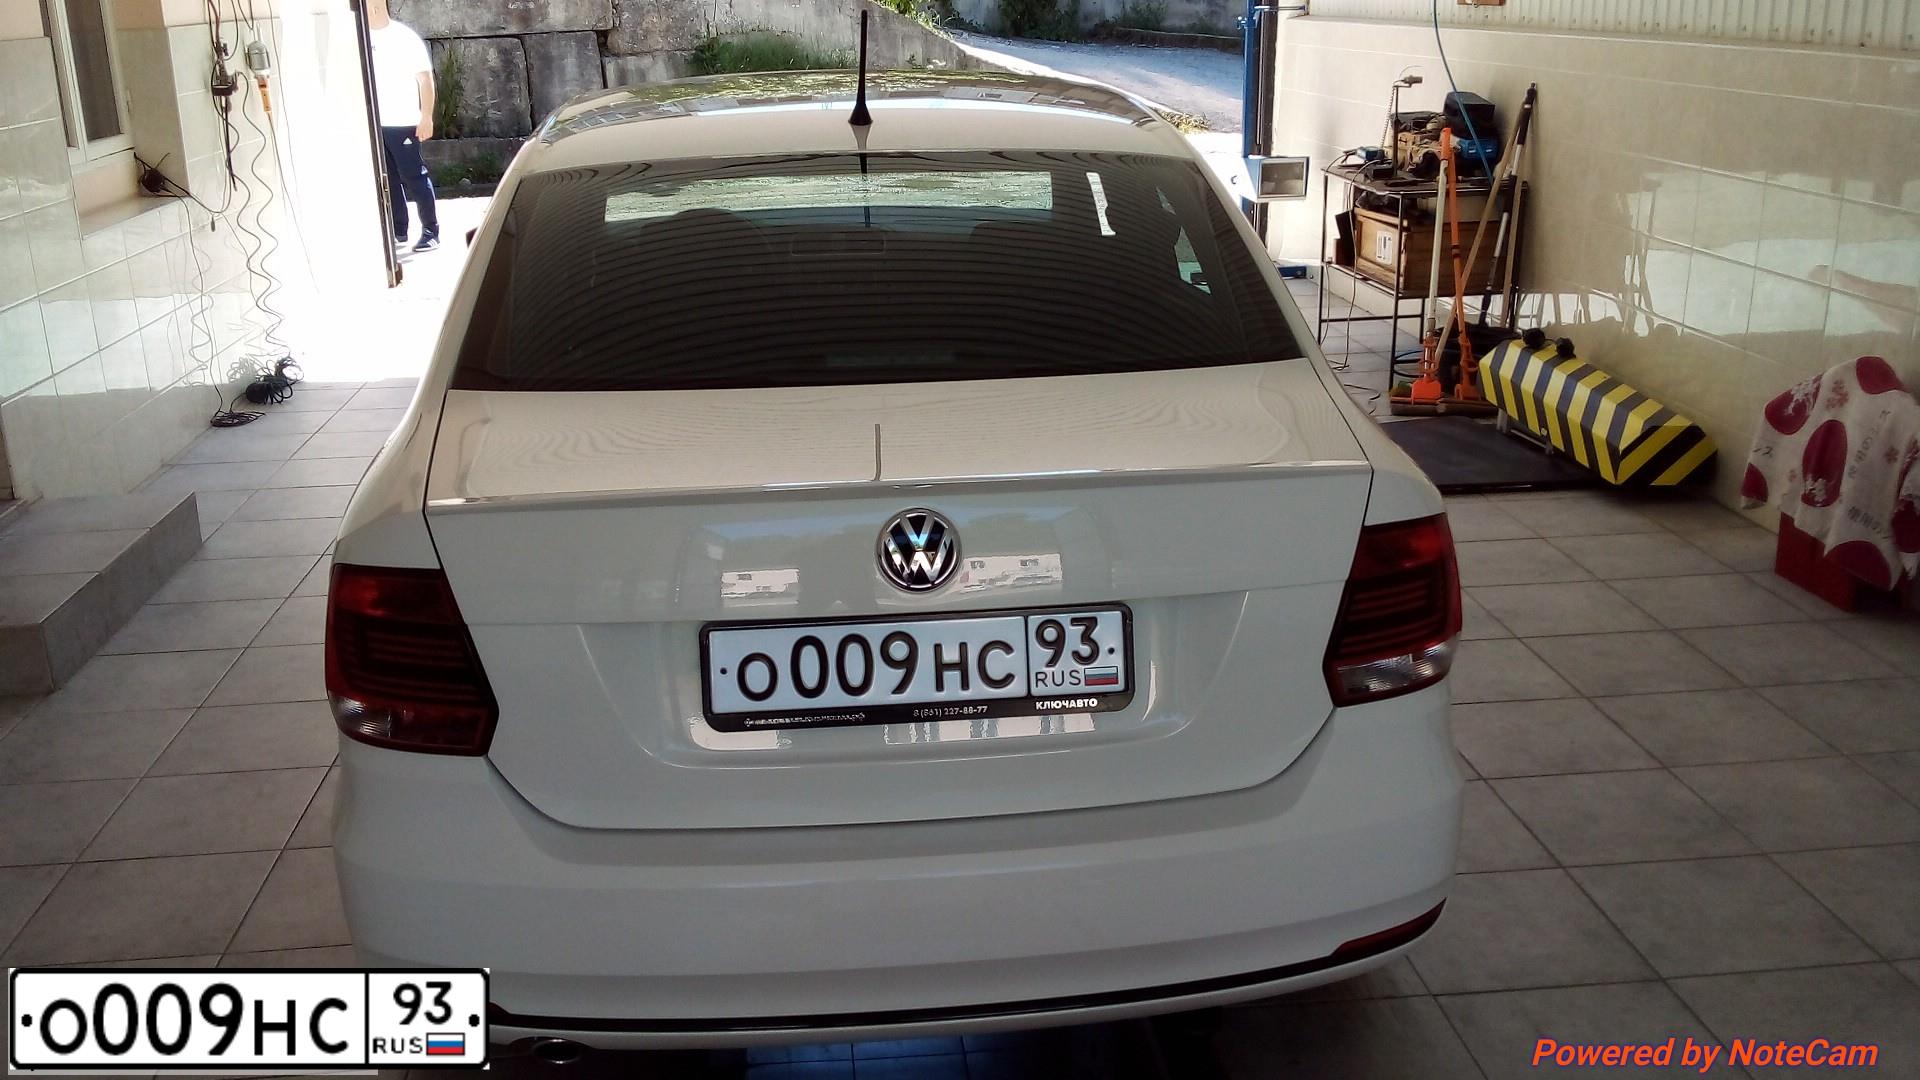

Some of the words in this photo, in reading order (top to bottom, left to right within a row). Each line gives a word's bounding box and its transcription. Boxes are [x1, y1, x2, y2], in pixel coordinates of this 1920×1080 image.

[1035, 617, 1099, 668] 93
[1035, 670, 1081, 688] RUS
[1036, 698, 1098, 710] КЛЮЧАВТО
